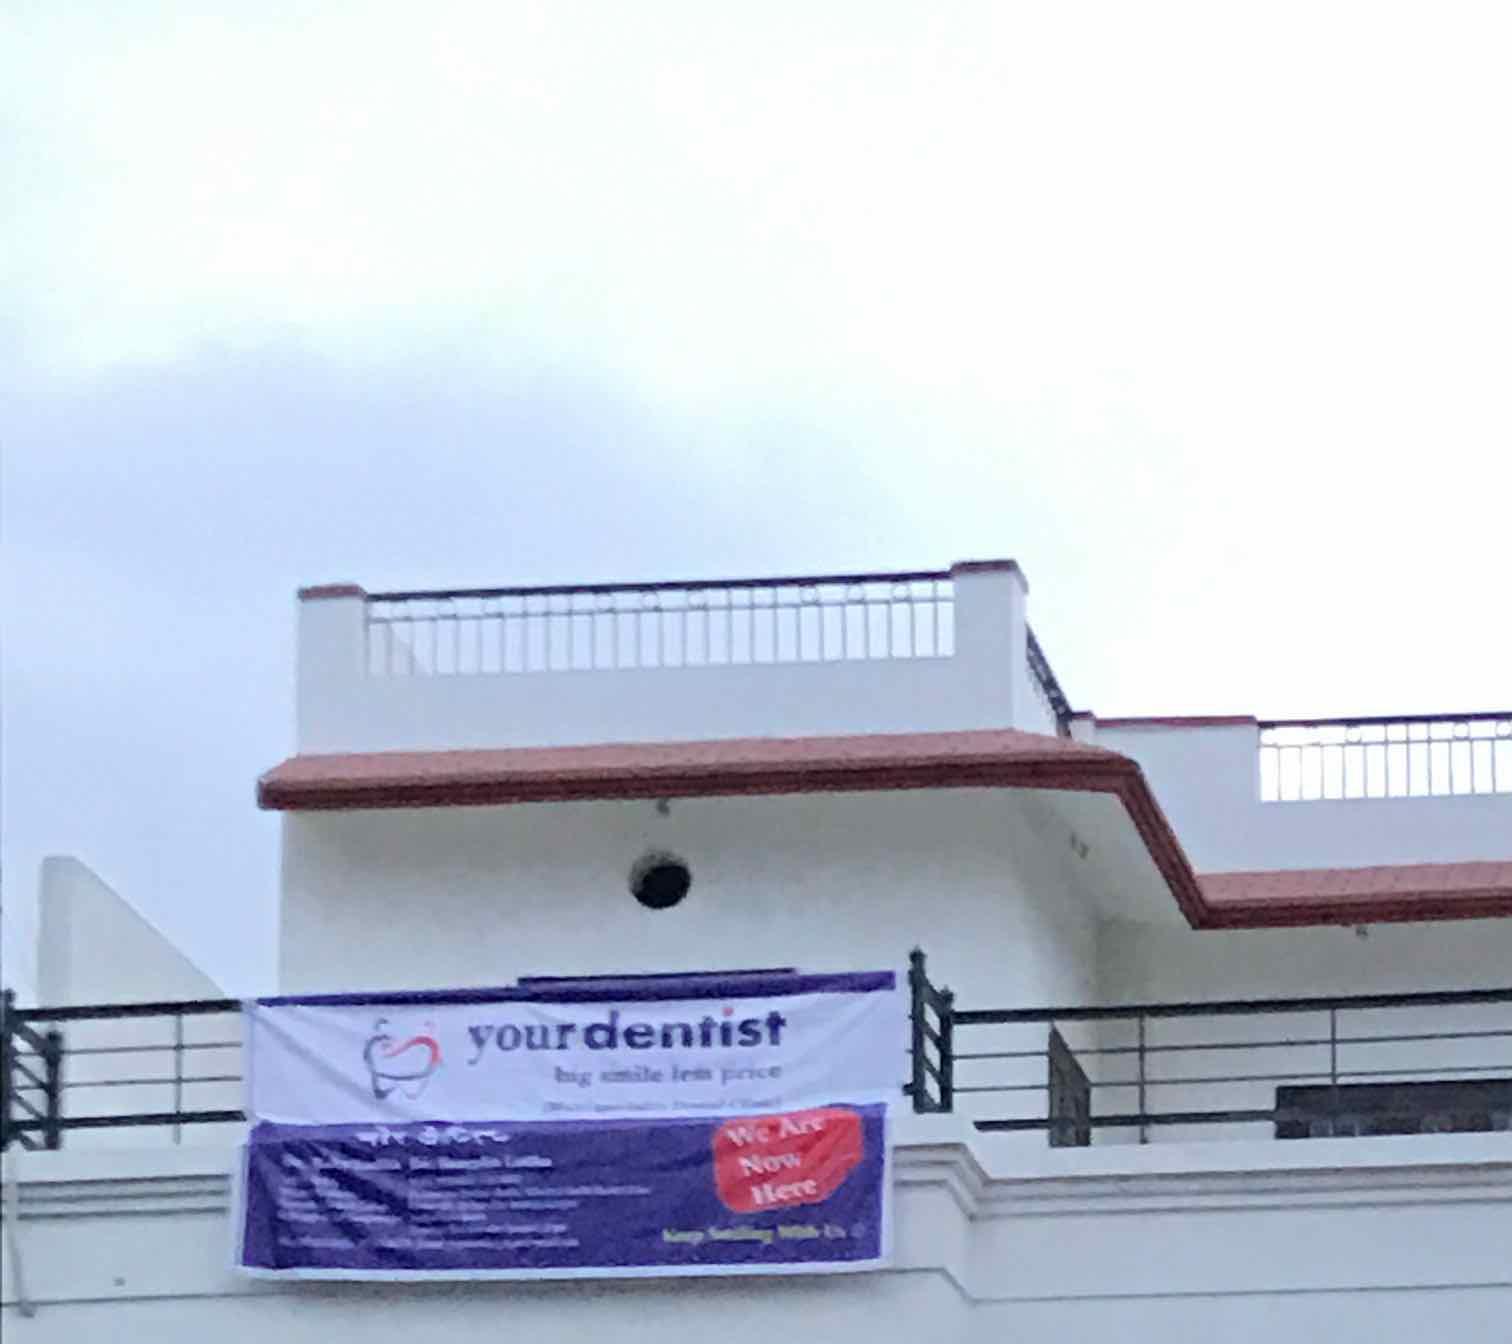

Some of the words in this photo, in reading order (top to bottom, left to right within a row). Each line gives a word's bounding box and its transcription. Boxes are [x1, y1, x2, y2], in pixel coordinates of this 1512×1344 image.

[555, 1066, 592, 1088] big
[600, 1066, 663, 1083] smile
[720, 1064, 782, 1085] price
[726, 1126, 769, 1147] We
[779, 1116, 826, 1137] Are
[737, 1153, 800, 1176] Now
[751, 1179, 817, 1205] Here
